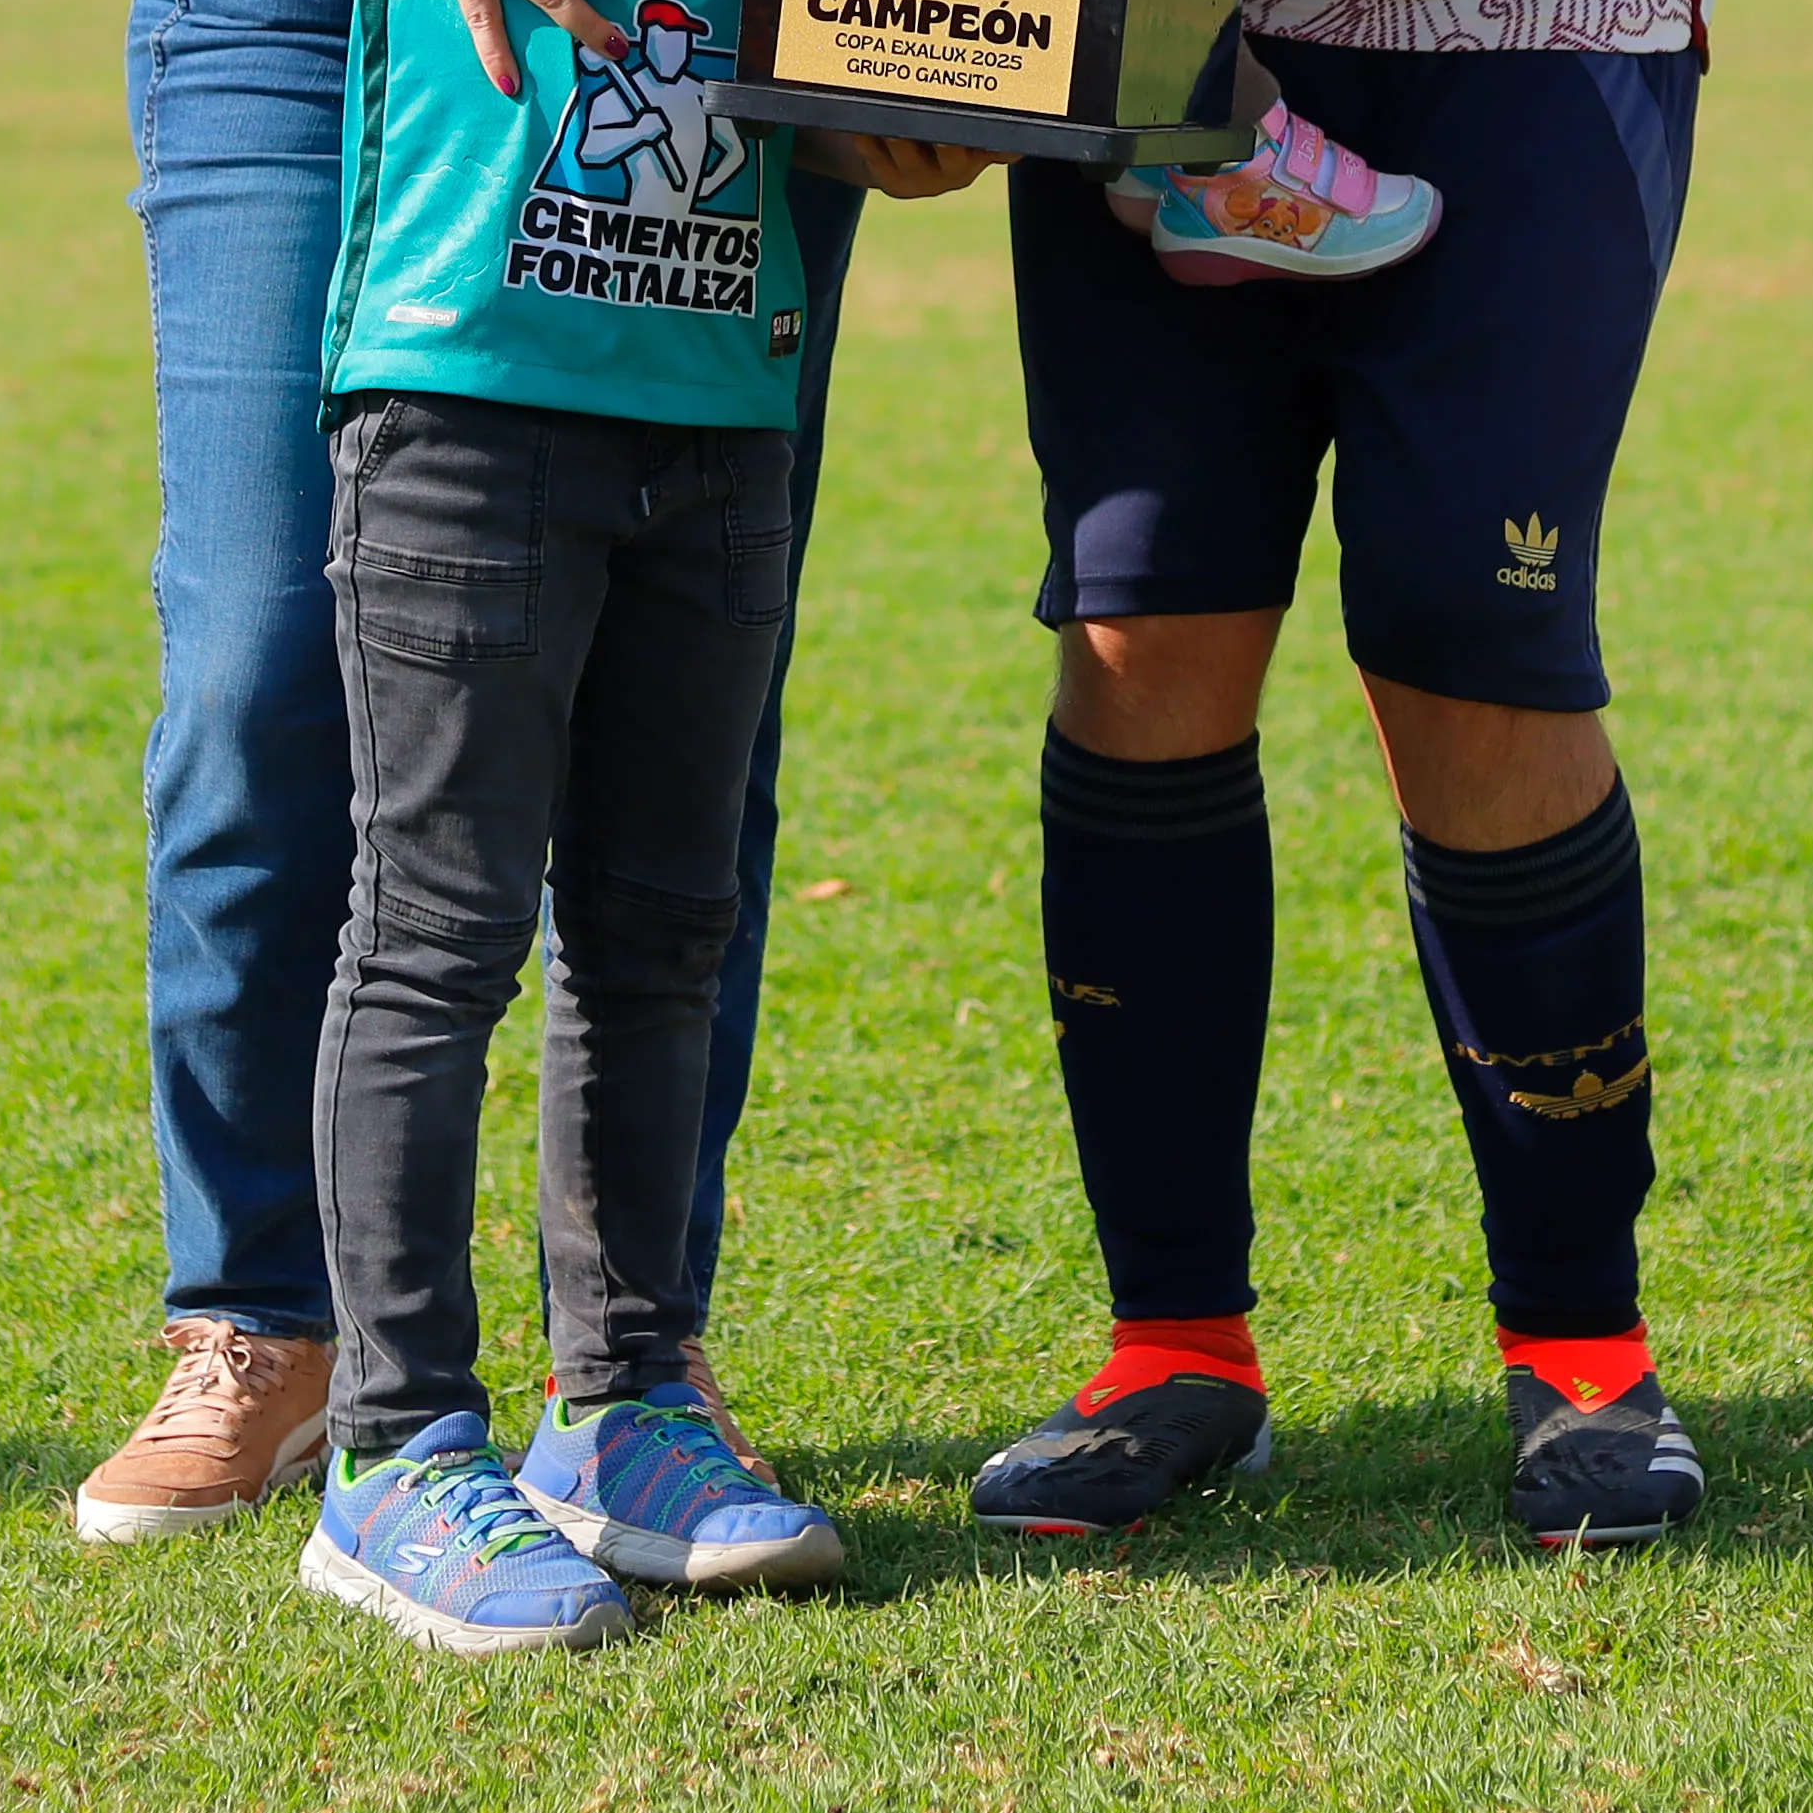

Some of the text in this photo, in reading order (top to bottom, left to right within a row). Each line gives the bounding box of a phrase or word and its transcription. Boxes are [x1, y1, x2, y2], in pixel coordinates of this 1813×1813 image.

[835, 32, 1023, 71] COPA EXALUX 2025
[846, 58, 998, 92] GRUPO GANSITO
[522, 197, 761, 269] CEMENTOS
[506, 243, 756, 316] FORTALEZA
[1496, 566, 1556, 591] adidas
